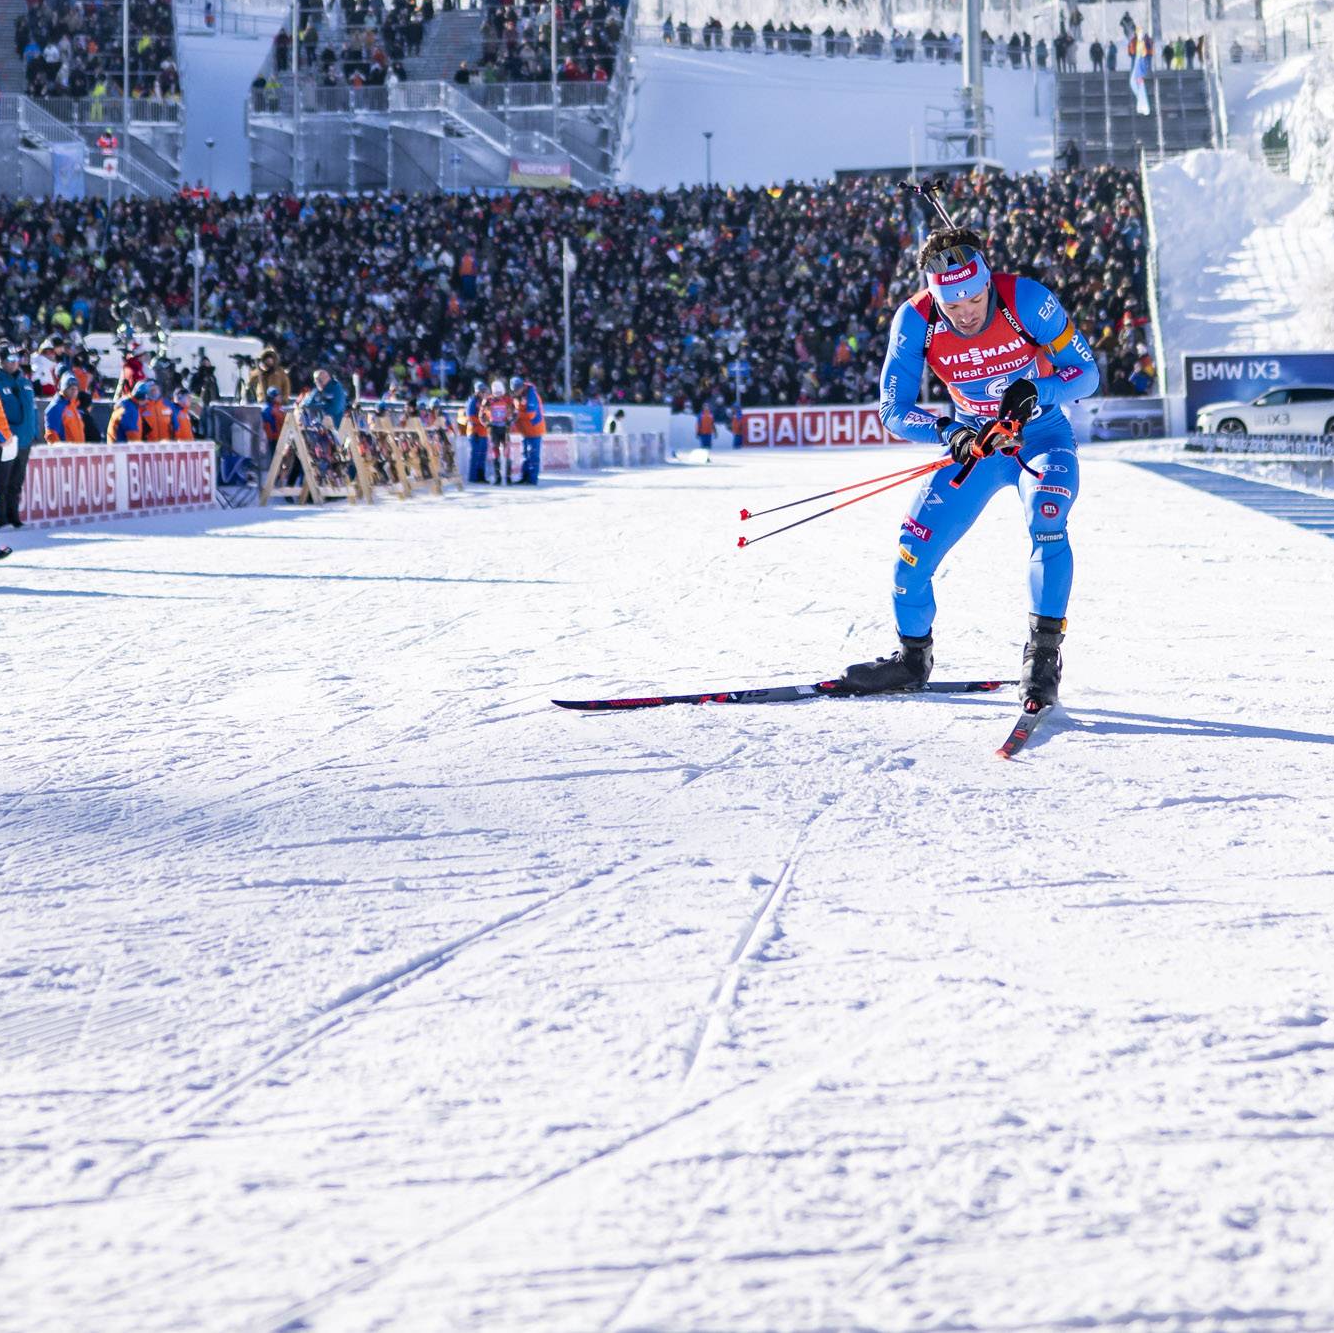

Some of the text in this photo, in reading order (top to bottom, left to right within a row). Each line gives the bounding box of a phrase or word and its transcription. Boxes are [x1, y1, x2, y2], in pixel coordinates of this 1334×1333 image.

[941, 268, 972, 283] felicetti
[1038, 294, 1058, 320] EA7
[938, 336, 1027, 366] VIESSMAN
[953, 367, 984, 380] Heat
[987, 354, 1029, 375] pumps
[1192, 360, 1281, 381] BMW iX3
[747, 417, 885, 443] BAUHA
[128, 453, 212, 502] BAUHAUS
